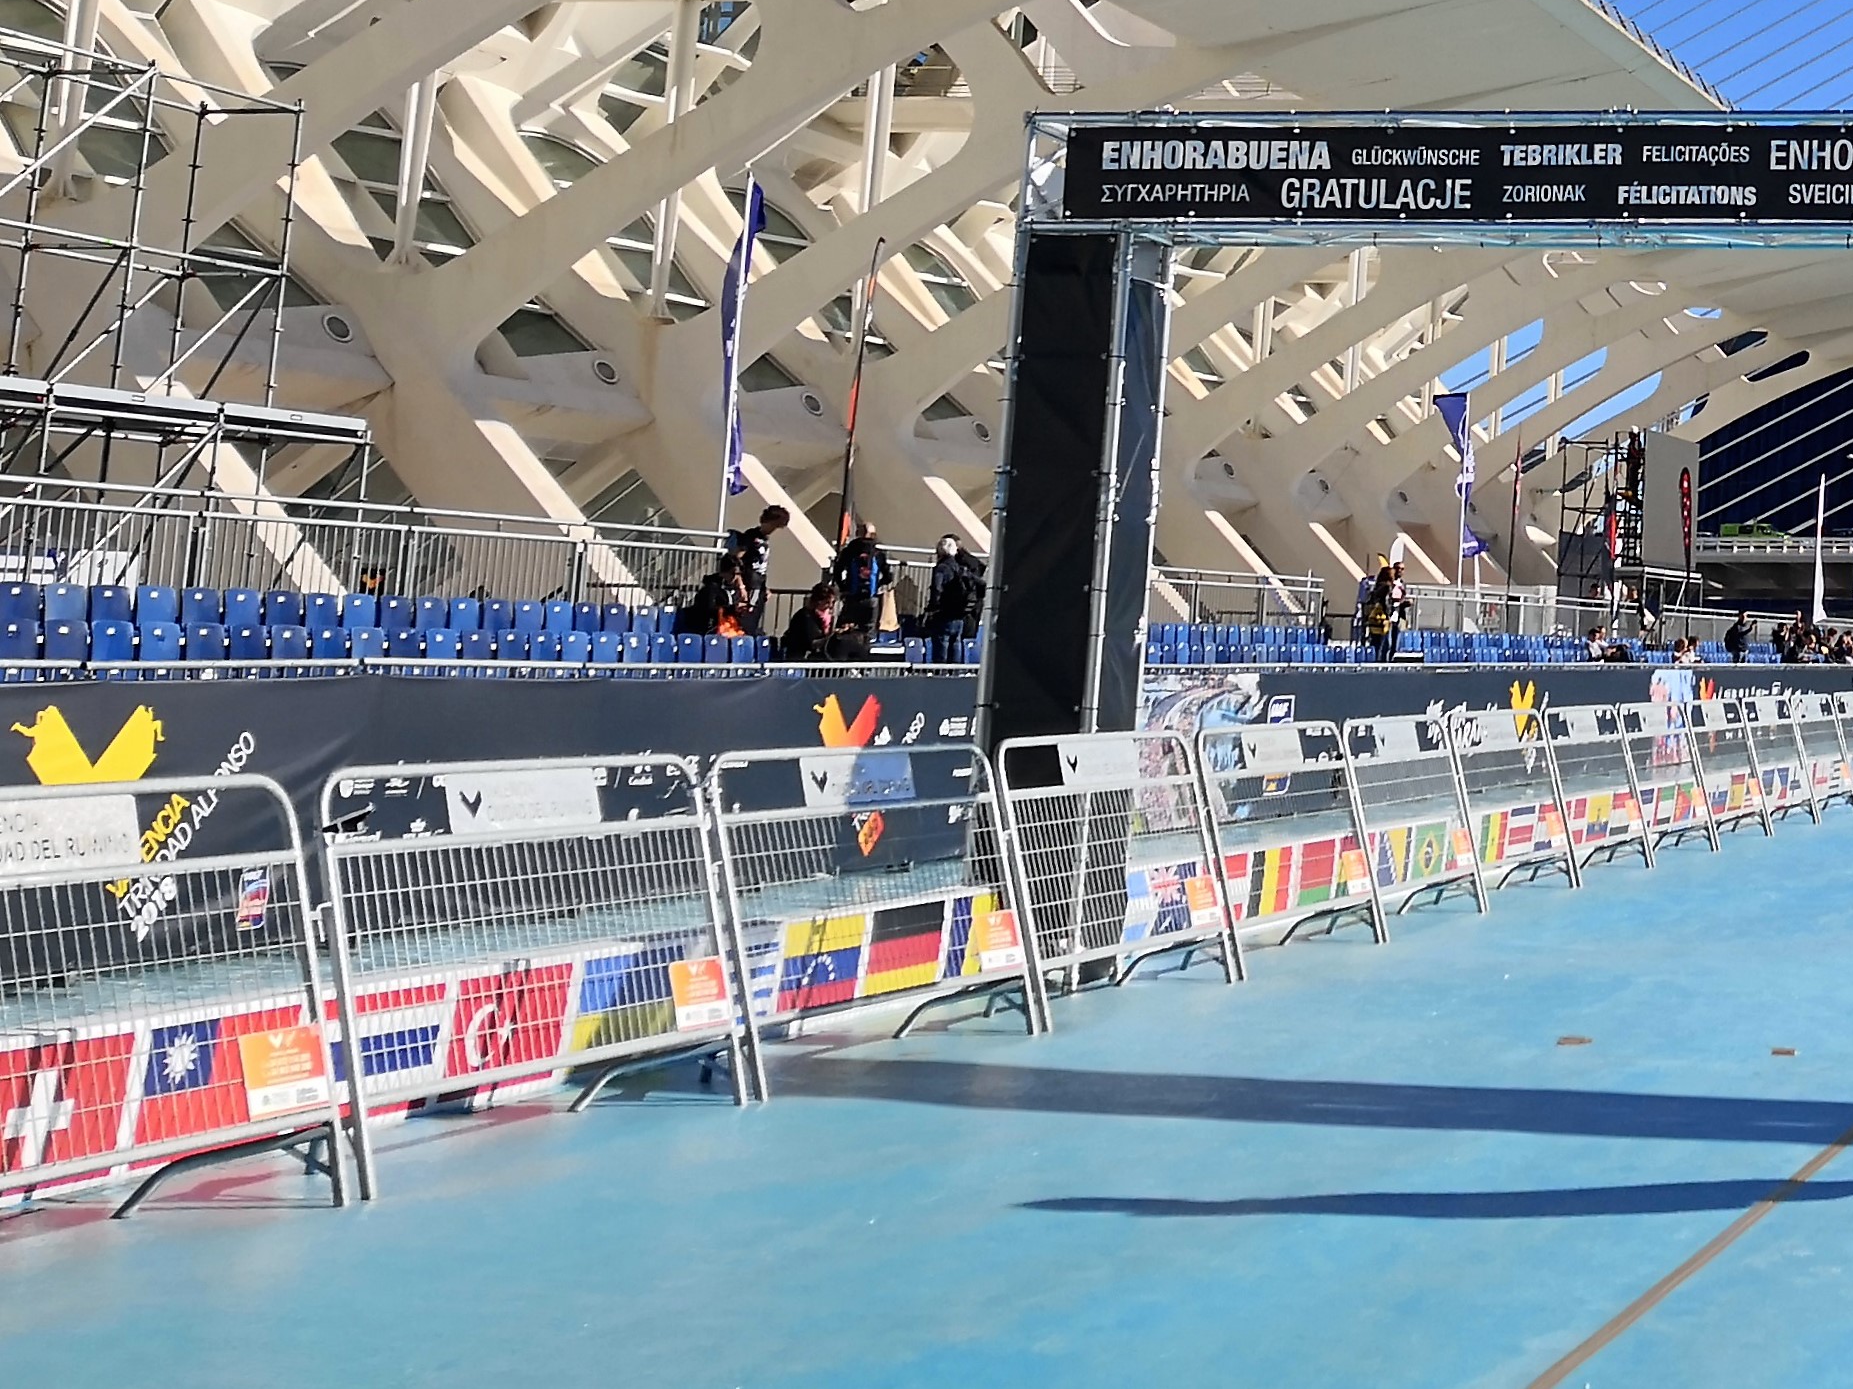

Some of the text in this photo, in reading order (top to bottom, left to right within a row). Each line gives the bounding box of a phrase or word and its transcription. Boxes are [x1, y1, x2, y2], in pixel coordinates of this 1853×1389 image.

[1103, 140, 1331, 169] ENHORABUENA
[1352, 146, 1480, 165] GLÜCKWÜNSCHE
[1501, 144, 1622, 166] TEBRIKLER
[1643, 143, 1749, 166] FELICITAÇÕES
[1281, 178, 1472, 210] GRATULACJE
[1503, 185, 1585, 202] ZORIONAK
[1618, 181, 1756, 205] FÉLICITATIONS
[131, 876, 177, 943] 2018
